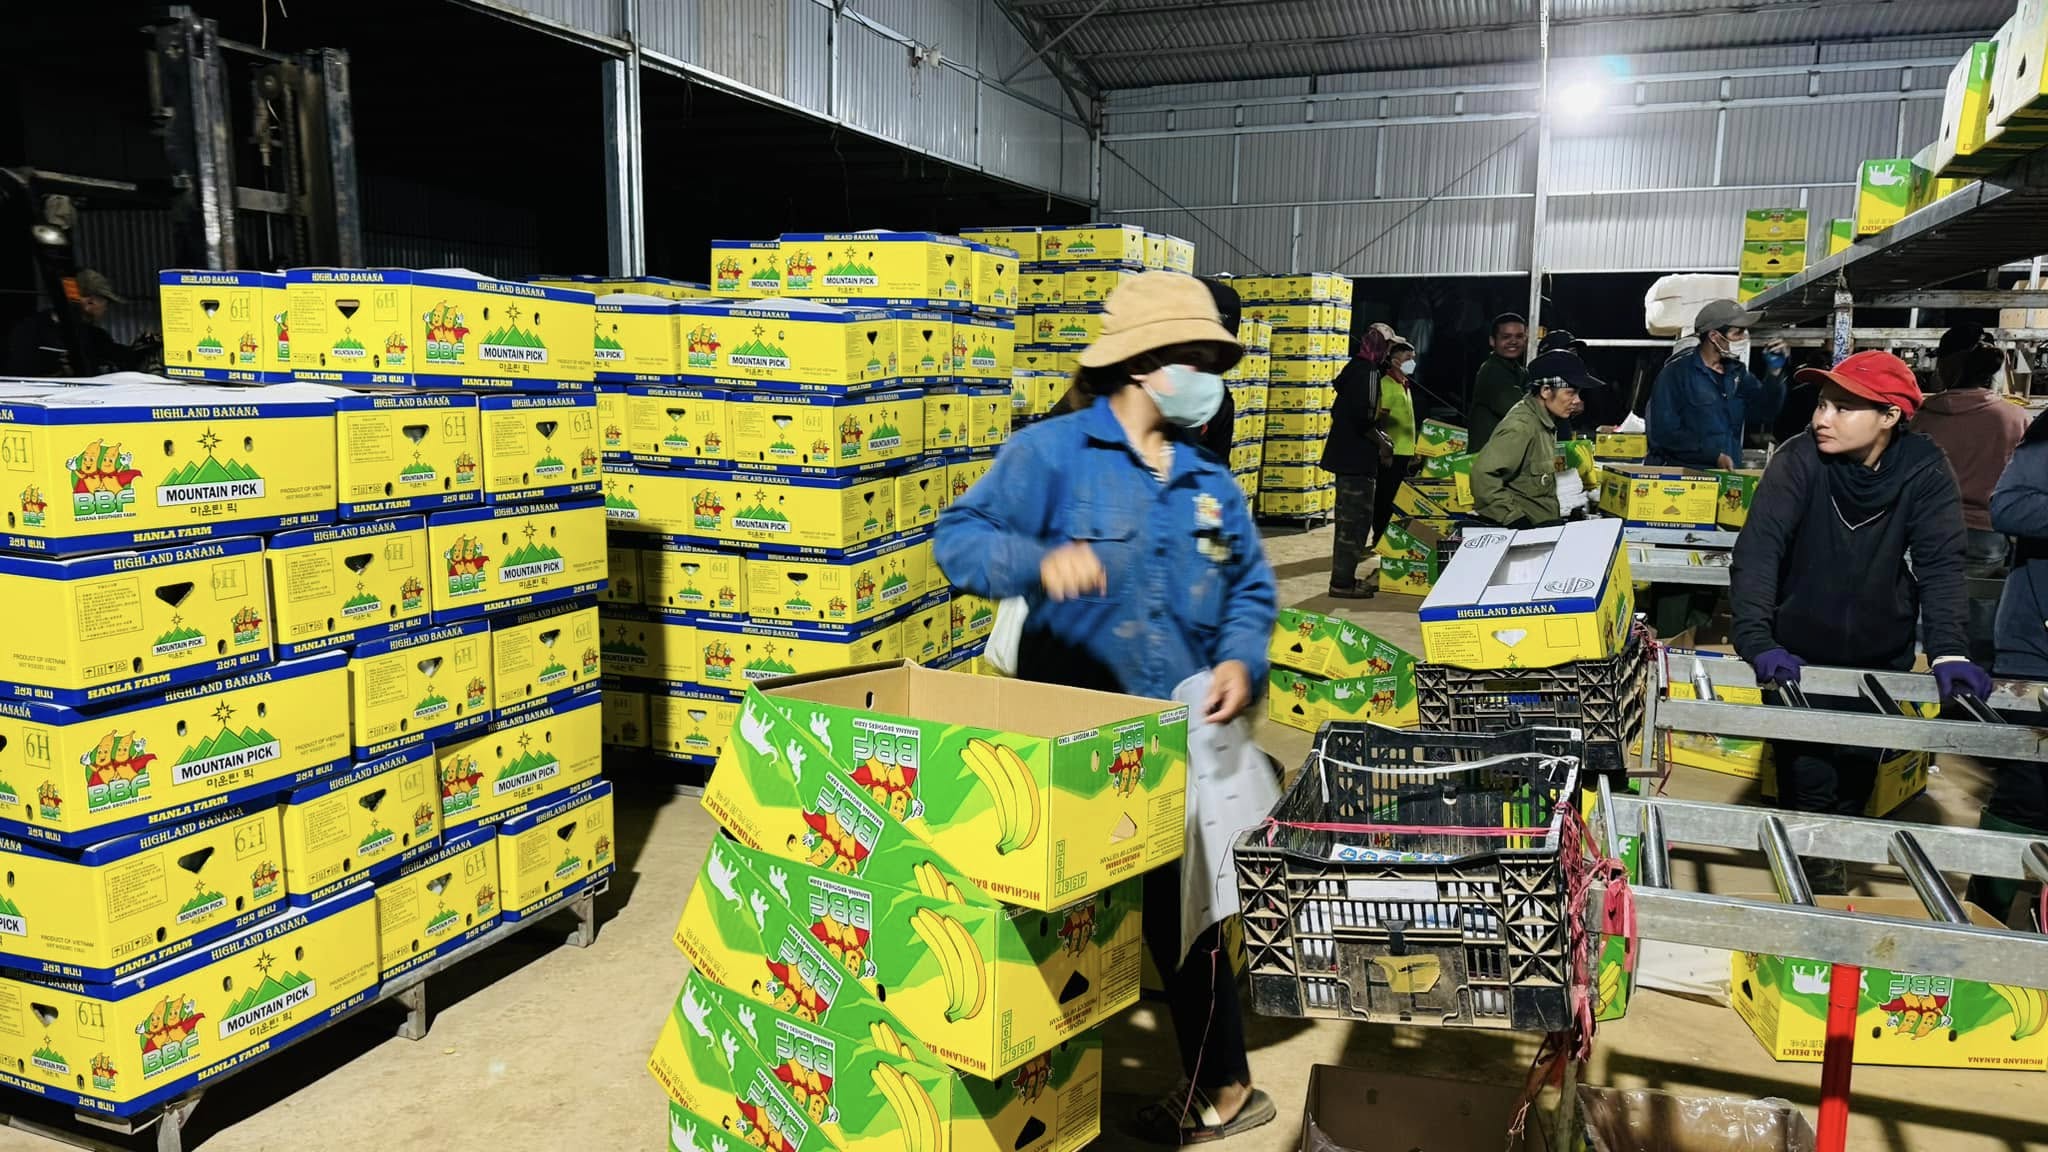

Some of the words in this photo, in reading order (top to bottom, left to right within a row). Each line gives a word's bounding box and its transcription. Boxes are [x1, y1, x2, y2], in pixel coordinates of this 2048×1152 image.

[312, 273, 349, 282] HIGHLAND
[351, 273, 383, 282] BANANA
[751, 279, 778, 288] MOUNTAIN
[826, 277, 856, 285] MOUNTAIN
[858, 277, 874, 285] PICK
[477, 282, 514, 293] HIGHLAND
[515, 286, 545, 298] BANANA
[426, 341, 464, 360] BBF
[484, 347, 524, 360] MOUNTAIN
[526, 350, 543, 360] PICK
[604, 351, 621, 359] PICK
[689, 352, 717, 365] BBF
[731, 356, 765, 366] MOUNTAIN
[767, 358, 786, 368] PICK
[374, 398, 415, 407] HIGHLAND
[417, 396, 450, 406] BANANA
[512, 398, 546, 407] HIGHLAND
[548, 397, 575, 405] BANANA
[152, 408, 210, 419] HIGHLAND
[212, 406, 259, 417] BANANA
[444, 416, 466, 437] 6H
[574, 414, 593, 432] 6H
[74, 489, 136, 517] BBF
[166, 486, 228, 502] MOUNTAIN
[232, 484, 257, 497] PICK
[522, 490, 544, 498] FARM
[353, 504, 383, 512] HANLA
[386, 500, 411, 509] FARM
[494, 506, 528, 518] HIGHLAND
[530, 503, 559, 513] BANANA
[133, 530, 175, 542] HANLA
[177, 526, 212, 538] FARM
[313, 527, 358, 541] HIGHLAND
[361, 522, 396, 533] BANANA
[735, 519, 766, 529] MOUNTAIN
[768, 520, 786, 530] PICK
[113, 554, 174, 569] HIGHLAND
[176, 546, 224, 560] BANANA
[504, 564, 541, 578] MOUNTAIN
[543, 561, 559, 573] PICK
[449, 574, 486, 592] BBF
[344, 605, 367, 615] MOUNTAIN
[483, 600, 510, 611] HANLA
[512, 596, 532, 606] FARM
[1457, 608, 1508, 618] HIGHLAND
[1510, 605, 1556, 614] BANANA
[156, 640, 187, 653] MOUNTAIN
[189, 638, 202, 646] PICK
[294, 638, 324, 653] HANLA
[328, 634, 354, 645] FARM
[389, 632, 429, 650] HIGHLAND
[431, 627, 463, 640] BANANA
[88, 681, 133, 699] HANLA
[136, 674, 171, 688] FARM
[165, 682, 222, 702] HIGHLAND
[224, 672, 272, 689] BANANA
[416, 706, 436, 717] MOUNTAIN
[437, 704, 446, 712] PICK
[501, 704, 527, 716] HANLA
[528, 696, 548, 708] FARM
[26, 736, 50, 761] 6H
[370, 739, 397, 753] HANLA
[400, 733, 424, 746] FARM
[855, 731, 918, 768] BBF
[1114, 728, 1144, 754] BBF
[180, 756, 244, 779] MOUNTAIN
[247, 746, 273, 763] PICK
[330, 766, 371, 790] HIGHLAND
[374, 755, 407, 773] BANANA
[498, 774, 536, 792] MOUNTAIN
[538, 766, 556, 779] PICK
[827, 774, 840, 786] FARM
[89, 777, 150, 807] BBF
[443, 791, 479, 813] BBF
[839, 788, 862, 808] BROTHERS
[148, 806, 192, 824] HANLA
[195, 796, 228, 811] FARM
[536, 804, 566, 822] HIGHLAND
[568, 794, 592, 808] BANANA
[862, 807, 882, 826] BANANA
[140, 822, 196, 849] HIGHLAND
[199, 807, 244, 827] BANANA
[818, 788, 881, 851] BBF
[359, 839, 381, 853] MOUNTAIN
[382, 834, 393, 843] PICK
[400, 854, 440, 876] HIGHLAND
[442, 839, 471, 858] BANANA
[465, 849, 486, 876] 6H
[311, 878, 339, 900] HANLA
[341, 869, 370, 886] FARM
[991, 881, 1040, 900] HIGHLAND
[180, 908, 208, 922] MOUNTAIN
[209, 901, 223, 910] PICK
[520, 900, 543, 916] HANLA
[544, 892, 563, 905] FARM
[810, 889, 870, 931] BBF
[427, 920, 448, 933] MOUNTAIN
[449, 915, 457, 923] PICK
[789, 926, 800, 939] FARM
[212, 933, 264, 960] HIGHLAND
[266, 916, 308, 938] BANANA
[115, 954, 157, 976] HANLA
[160, 940, 192, 956] FARM
[800, 938, 822, 962] BROTHERS
[780, 940, 838, 1004] BBF
[822, 963, 841, 982] BANANA
[1890, 976, 1950, 996] BBF
[79, 1002, 104, 1027] 6H
[226, 999, 283, 1033] MOUNTAIN
[286, 986, 310, 1008] PICK
[143, 1034, 199, 1074] BBF
[198, 1056, 234, 1081] HANLA
[237, 1041, 270, 1062] FARM
[777, 1033, 832, 1078] BBF
[940, 1050, 986, 1070] HIGHLAND
[1968, 1056, 2001, 1064] BANANA
[2003, 1057, 2044, 1066] HIGHLAND
[749, 1082, 805, 1151] BBF
